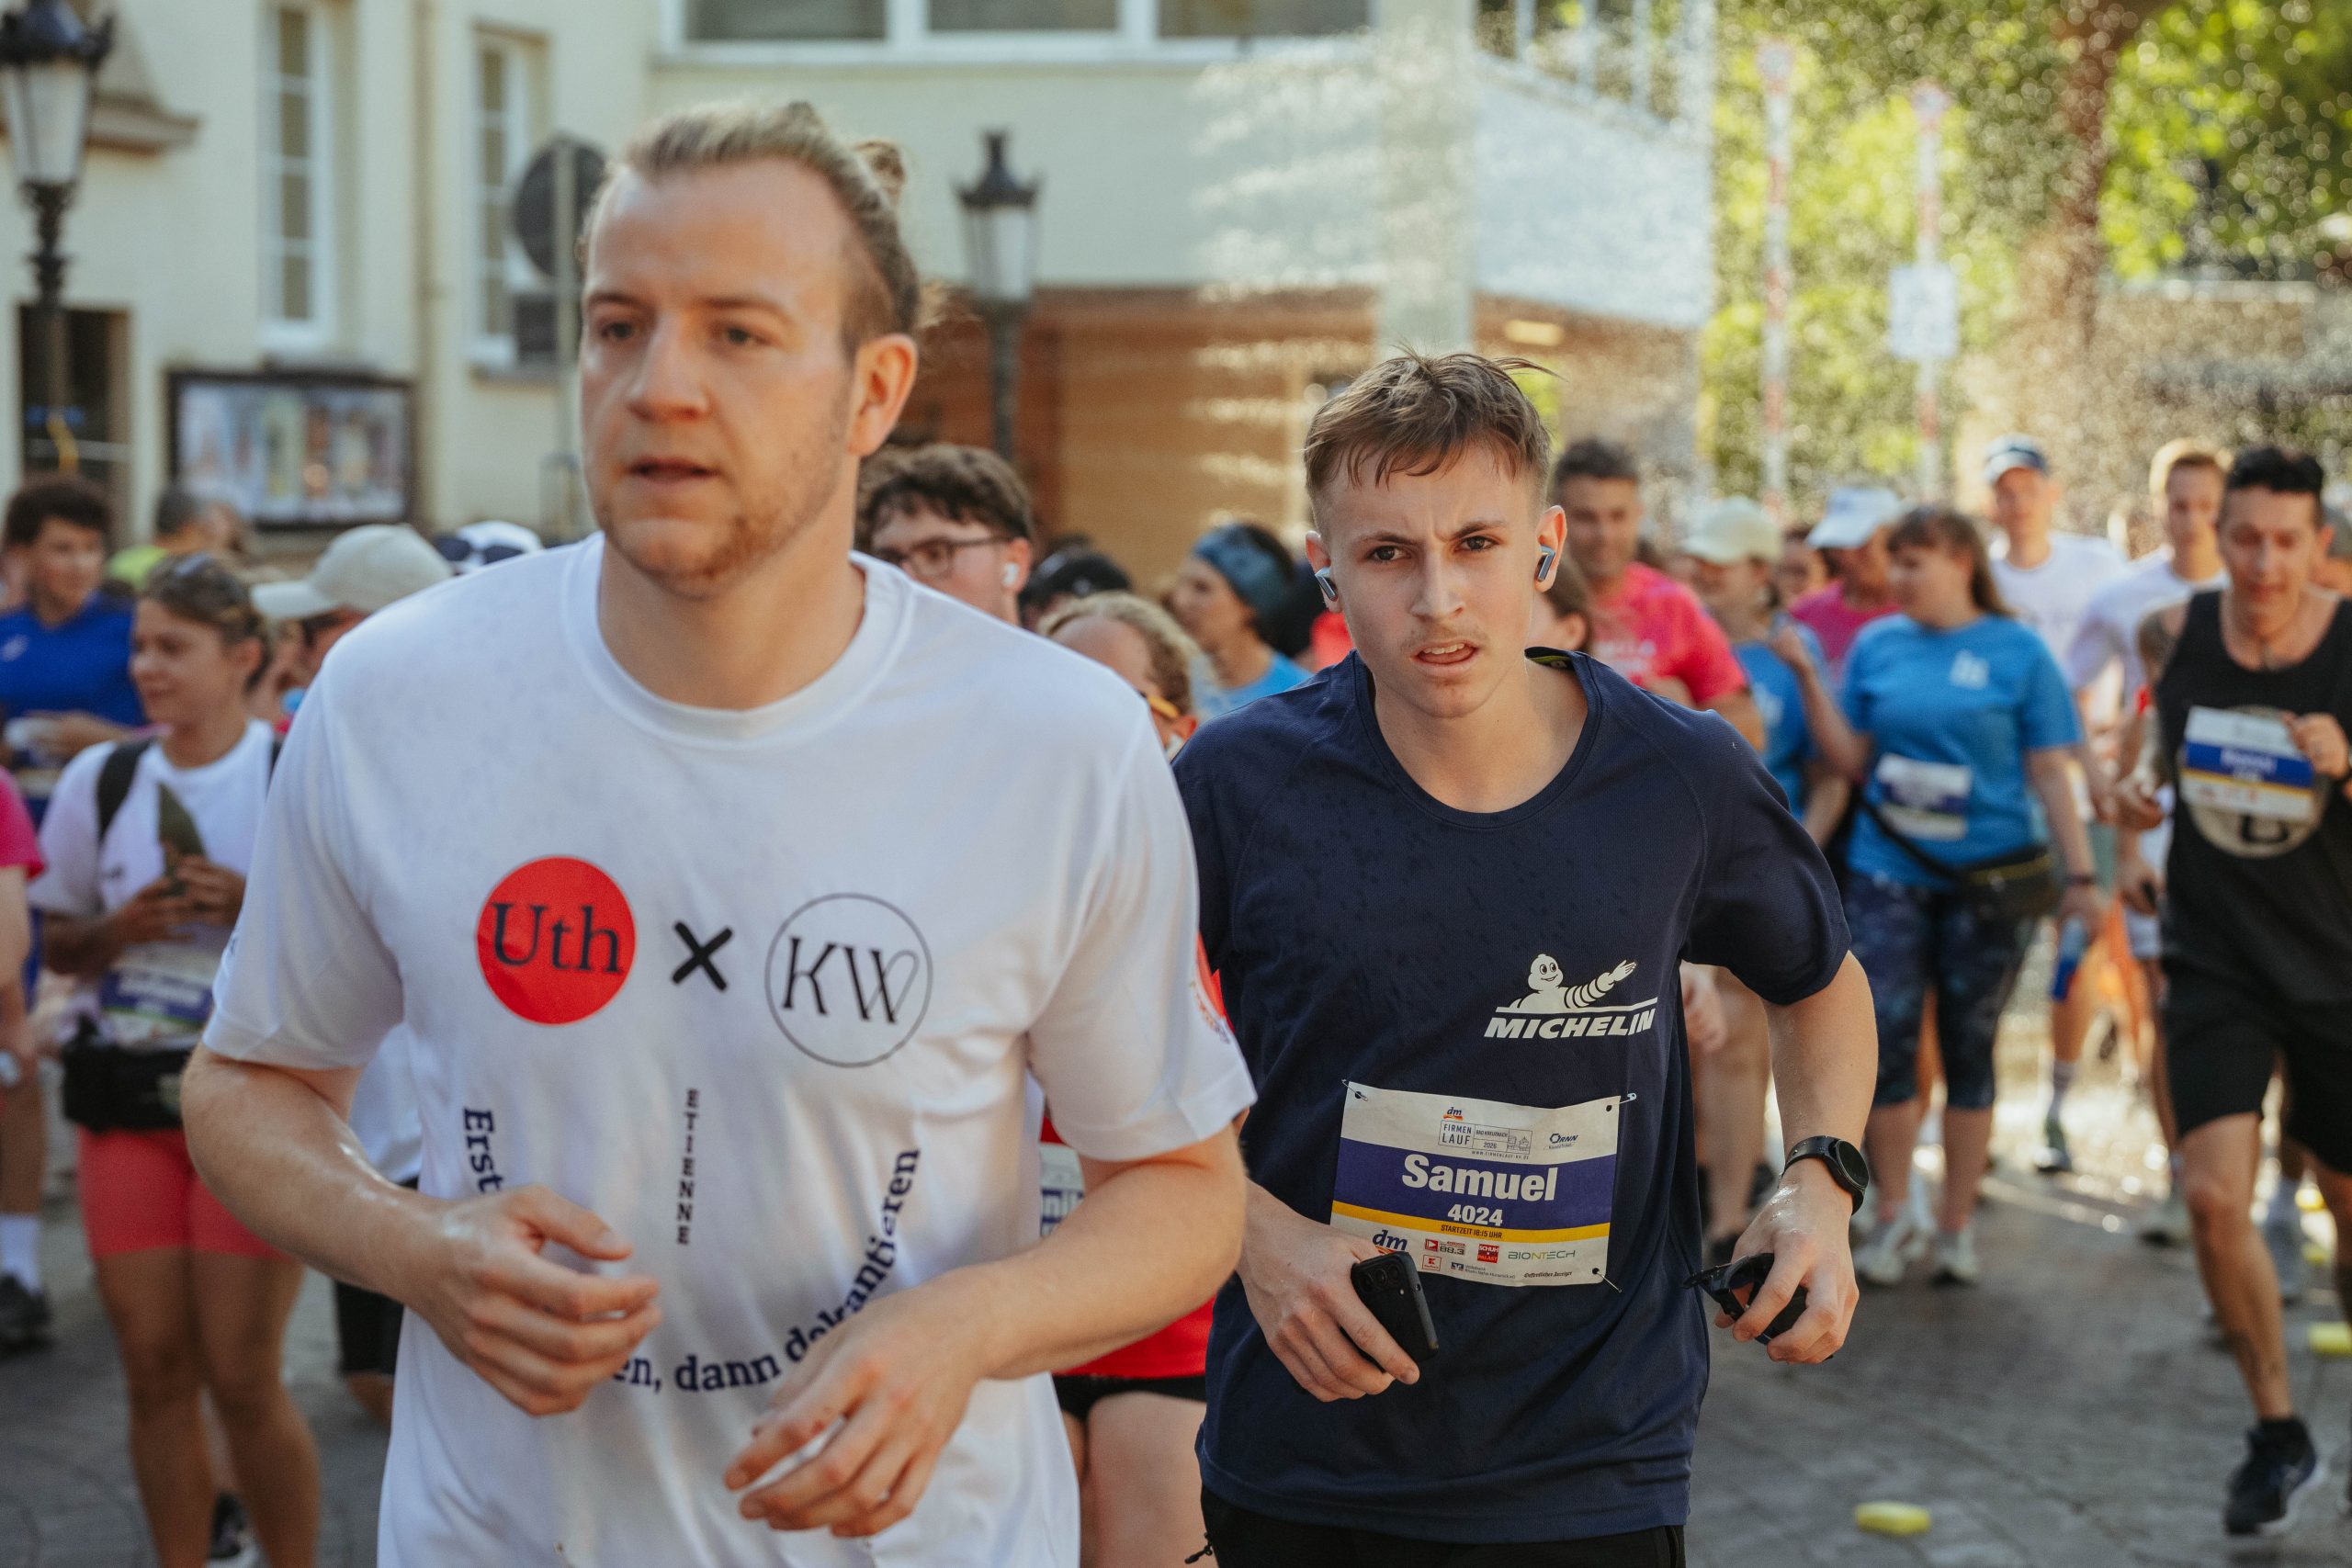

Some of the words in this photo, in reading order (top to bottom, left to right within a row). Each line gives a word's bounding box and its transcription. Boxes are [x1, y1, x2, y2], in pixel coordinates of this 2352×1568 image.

[491, 901, 624, 975] Uth
[782, 936, 919, 1025] KW
[1484, 1008, 1656, 1039] MICHELIN
[1446, 1107, 1463, 1116] dm
[1443, 1123, 1472, 1134] FIRMEN
[1442, 1133, 1471, 1145] LAUF
[676, 1089, 699, 1246] ETIENNE
[1402, 1154, 1559, 1201] Samuel
[1447, 1203, 1504, 1227] 4024
[1372, 1229, 1408, 1251] dm
[1441, 1224, 1473, 1235] STARTZEIT
[1473, 1228, 1488, 1237] 18:15
[1488, 1230, 1503, 1239] UHR
[463, 1108, 504, 1193] Erst
[674, 1354, 781, 1393] dann
[1439, 1246, 1465, 1256] 88.3
[1479, 1245, 1499, 1253] SCHUH
[1508, 1249, 1577, 1260] BIONTECH
